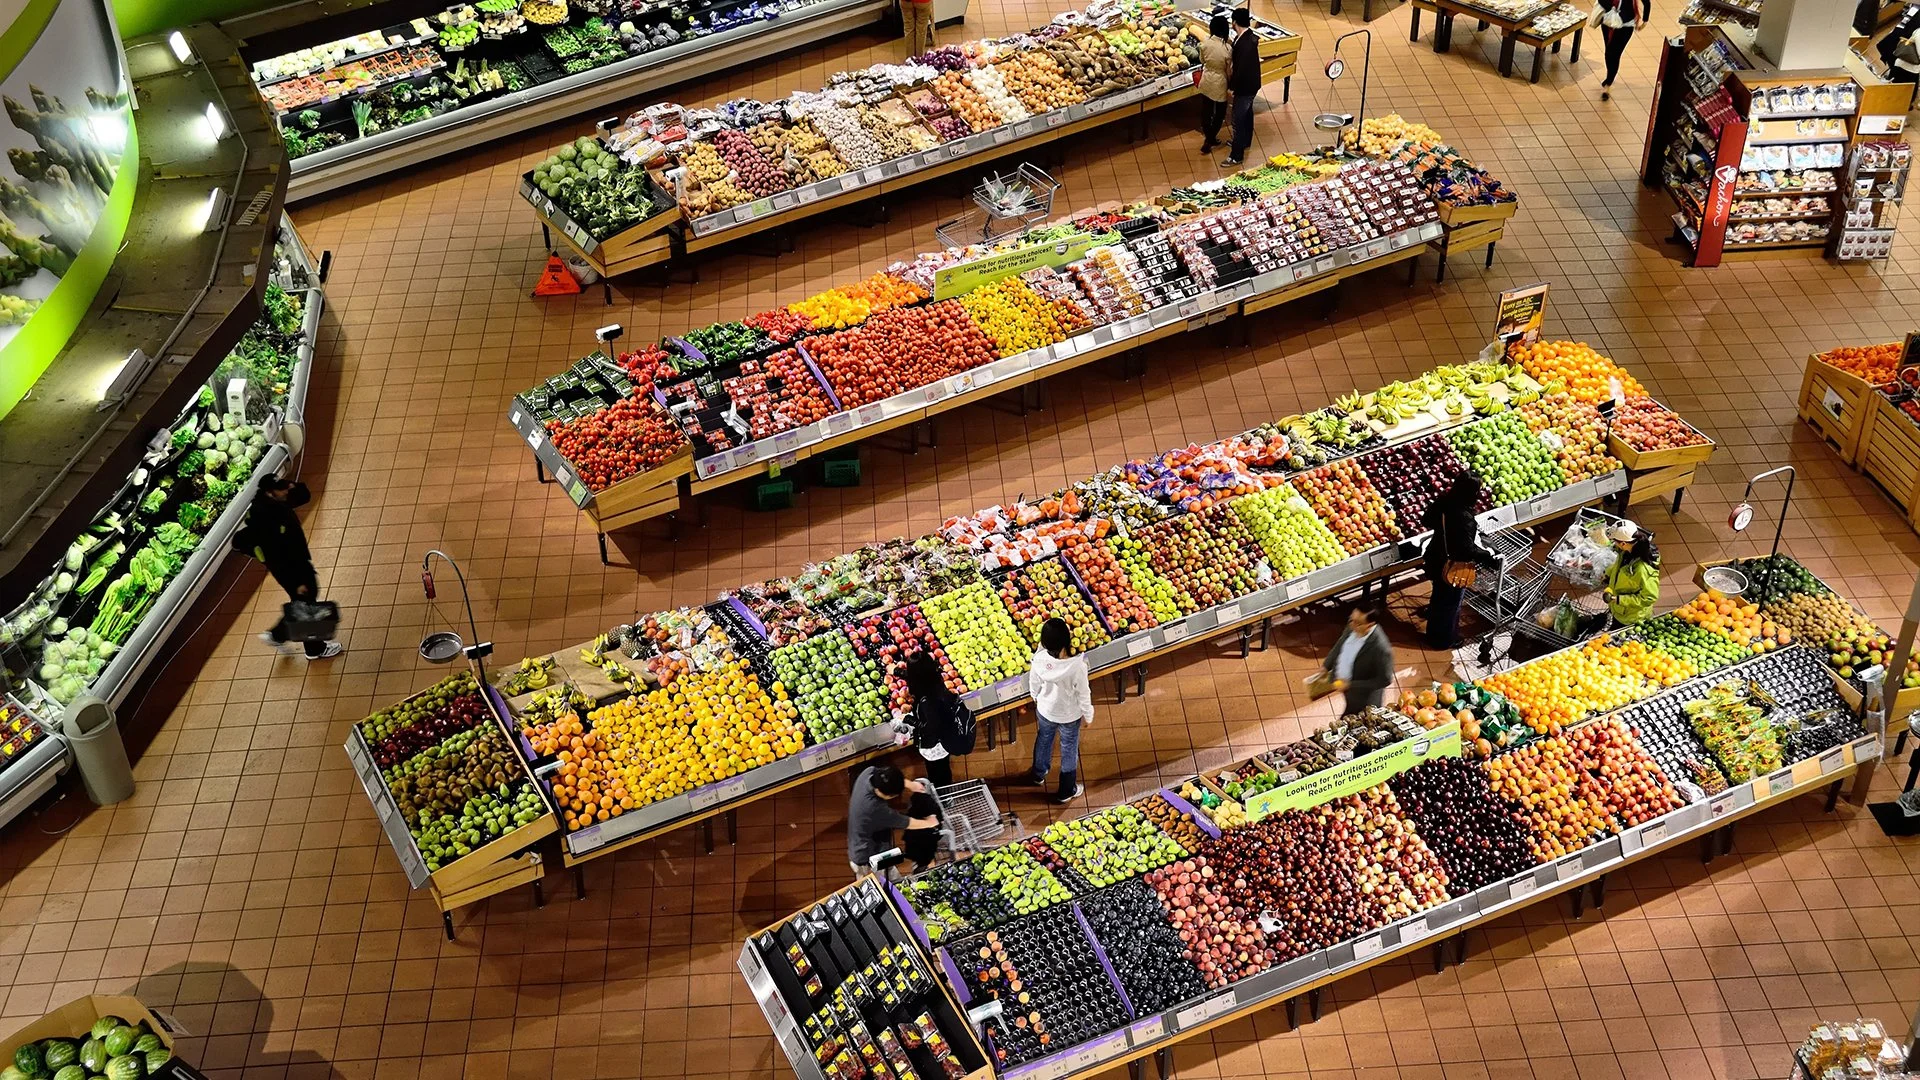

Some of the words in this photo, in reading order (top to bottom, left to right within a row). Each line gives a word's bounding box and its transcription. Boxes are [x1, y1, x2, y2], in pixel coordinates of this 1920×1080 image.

[964, 264, 986, 273] Looking
[987, 260, 996, 268] for
[998, 253, 1026, 264] nutritious
[1027, 246, 1053, 258] choices?
[979, 266, 998, 275] Reach
[998, 263, 1007, 271] for
[1008, 259, 1018, 268] the
[1019, 255, 1037, 266] Stars!
[1504, 303, 1516, 311] Easy
[1285, 782, 1317, 797] Looking
[1319, 776, 1331, 785] for
[1333, 761, 1372, 780] nutritious
[1374, 746, 1408, 764] choices?
[1308, 783, 1333, 797] Reach
[1334, 777, 1346, 787] for
[1348, 771, 1361, 784] the
[1363, 762, 1388, 777] Stars!
